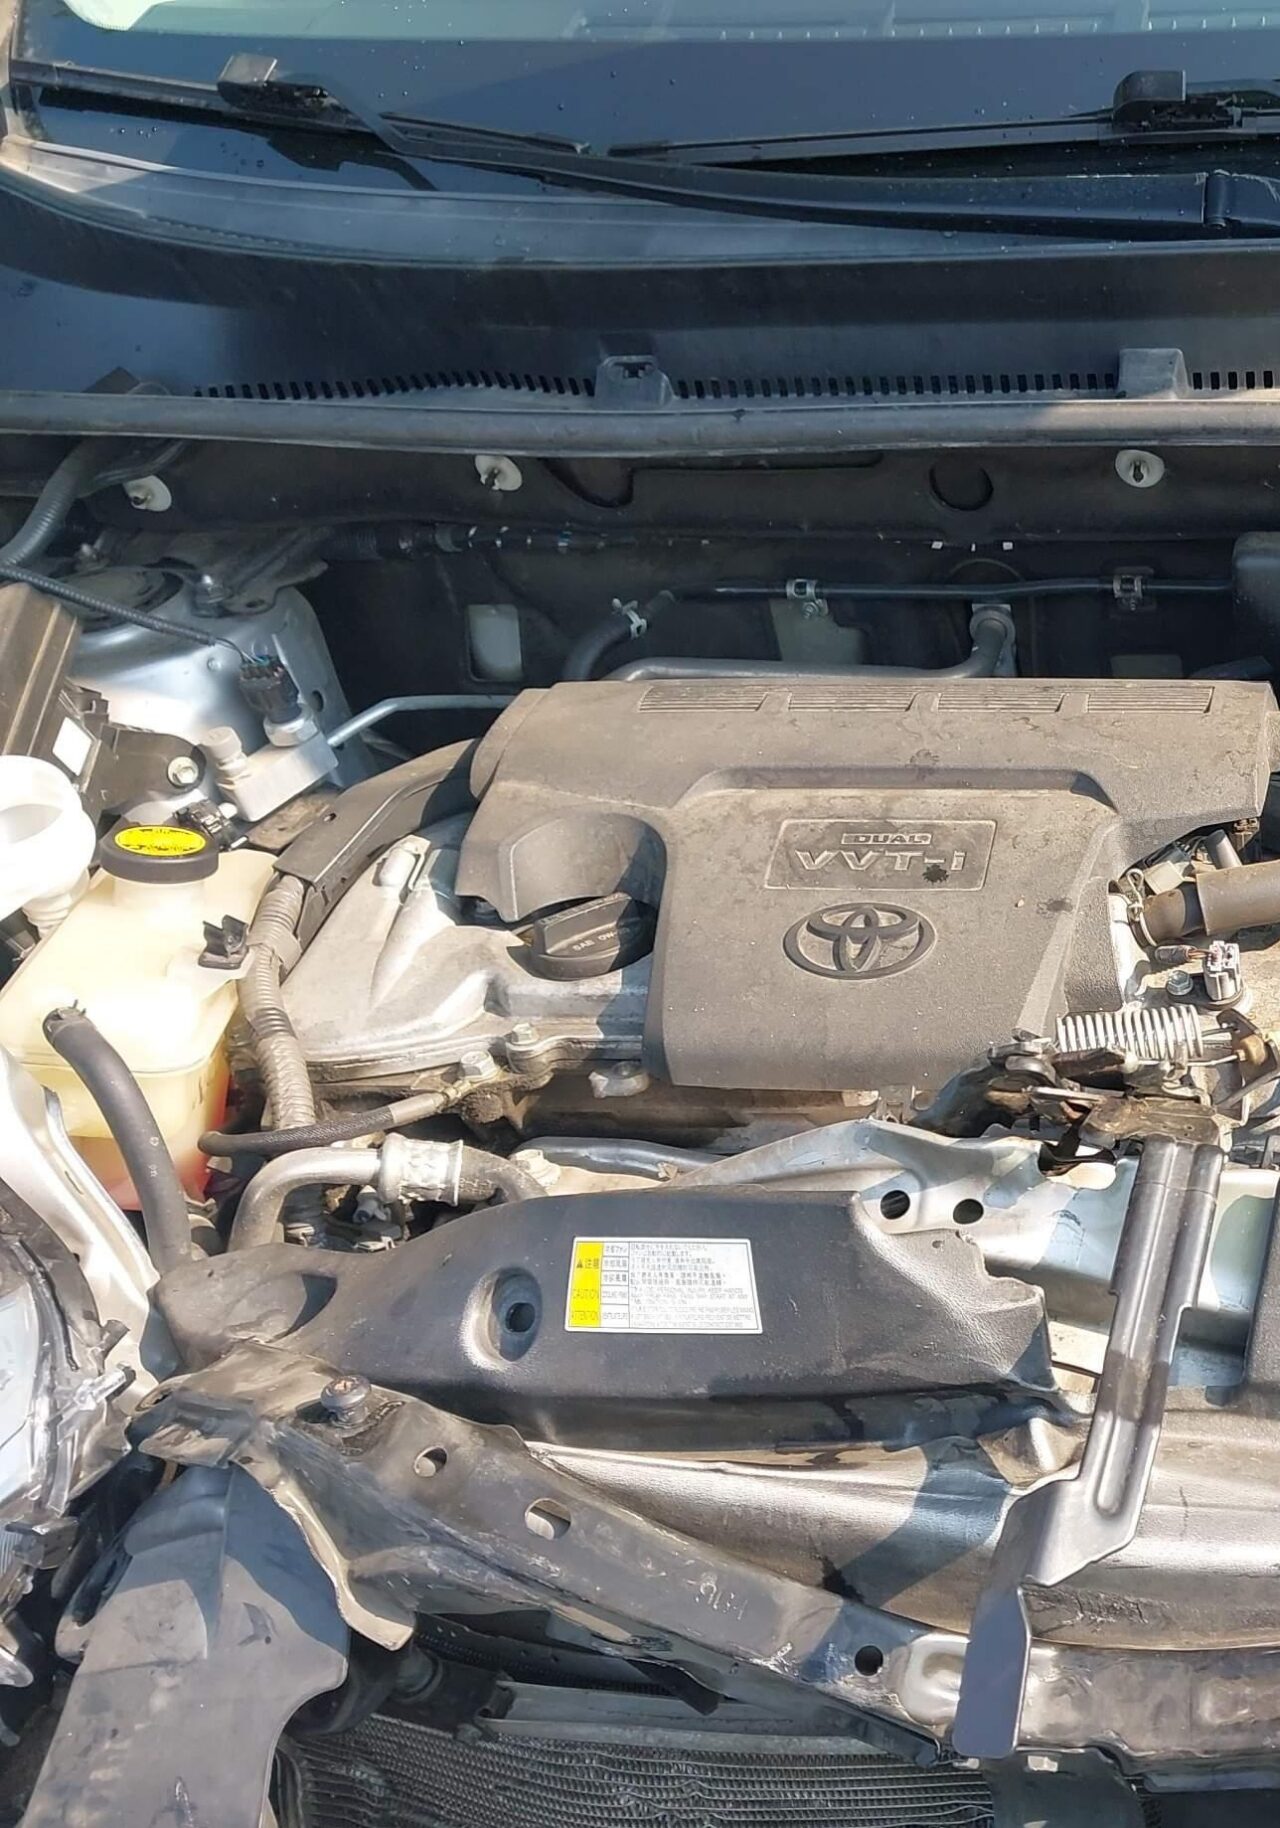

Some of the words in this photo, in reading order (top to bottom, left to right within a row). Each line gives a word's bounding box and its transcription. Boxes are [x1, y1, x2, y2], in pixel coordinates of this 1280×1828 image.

[854, 834, 924, 844] DUAL
[795, 849, 967, 871] VVT-i
[572, 940, 595, 951] SAE
